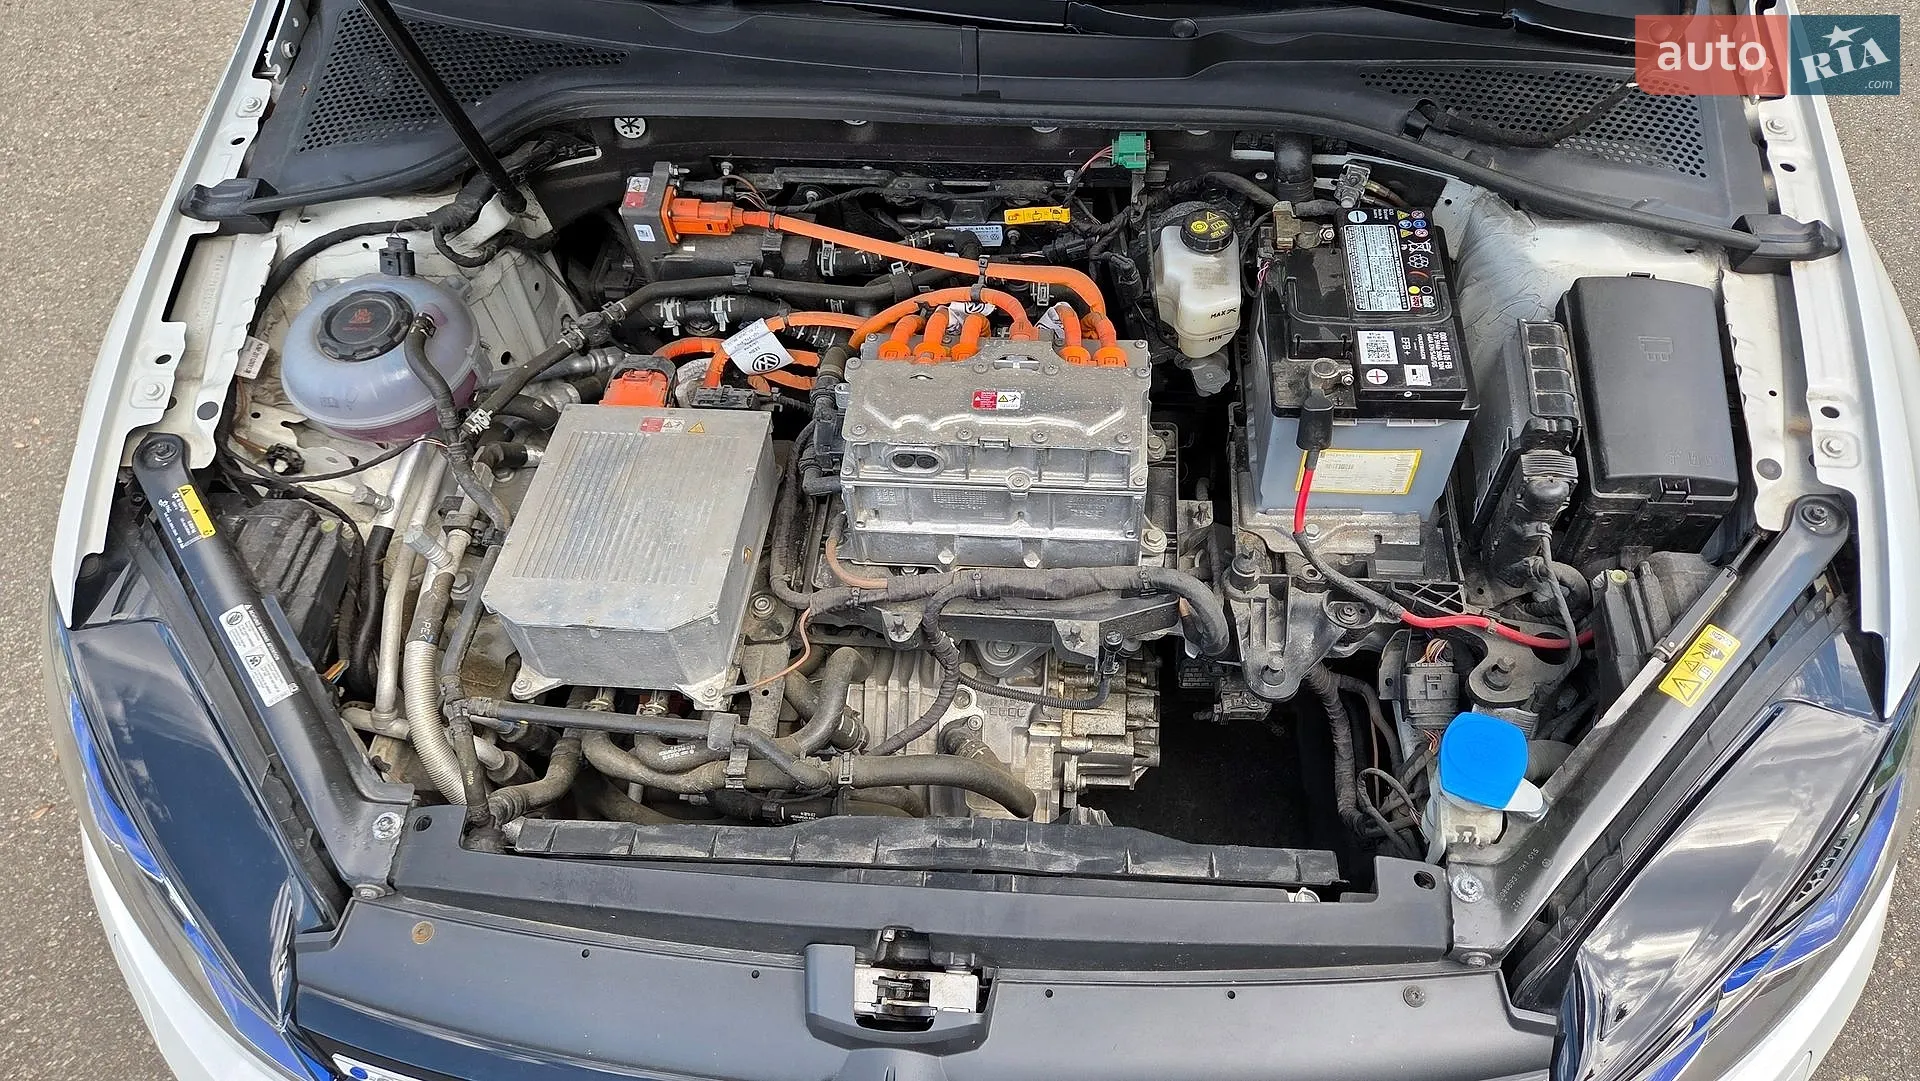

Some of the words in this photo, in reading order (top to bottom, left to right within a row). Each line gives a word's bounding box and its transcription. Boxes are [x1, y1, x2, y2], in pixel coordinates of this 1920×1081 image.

[1210, 310, 1227, 319] MAX
[1208, 335, 1223, 343] MIN
[1401, 337, 1411, 349] EFB
